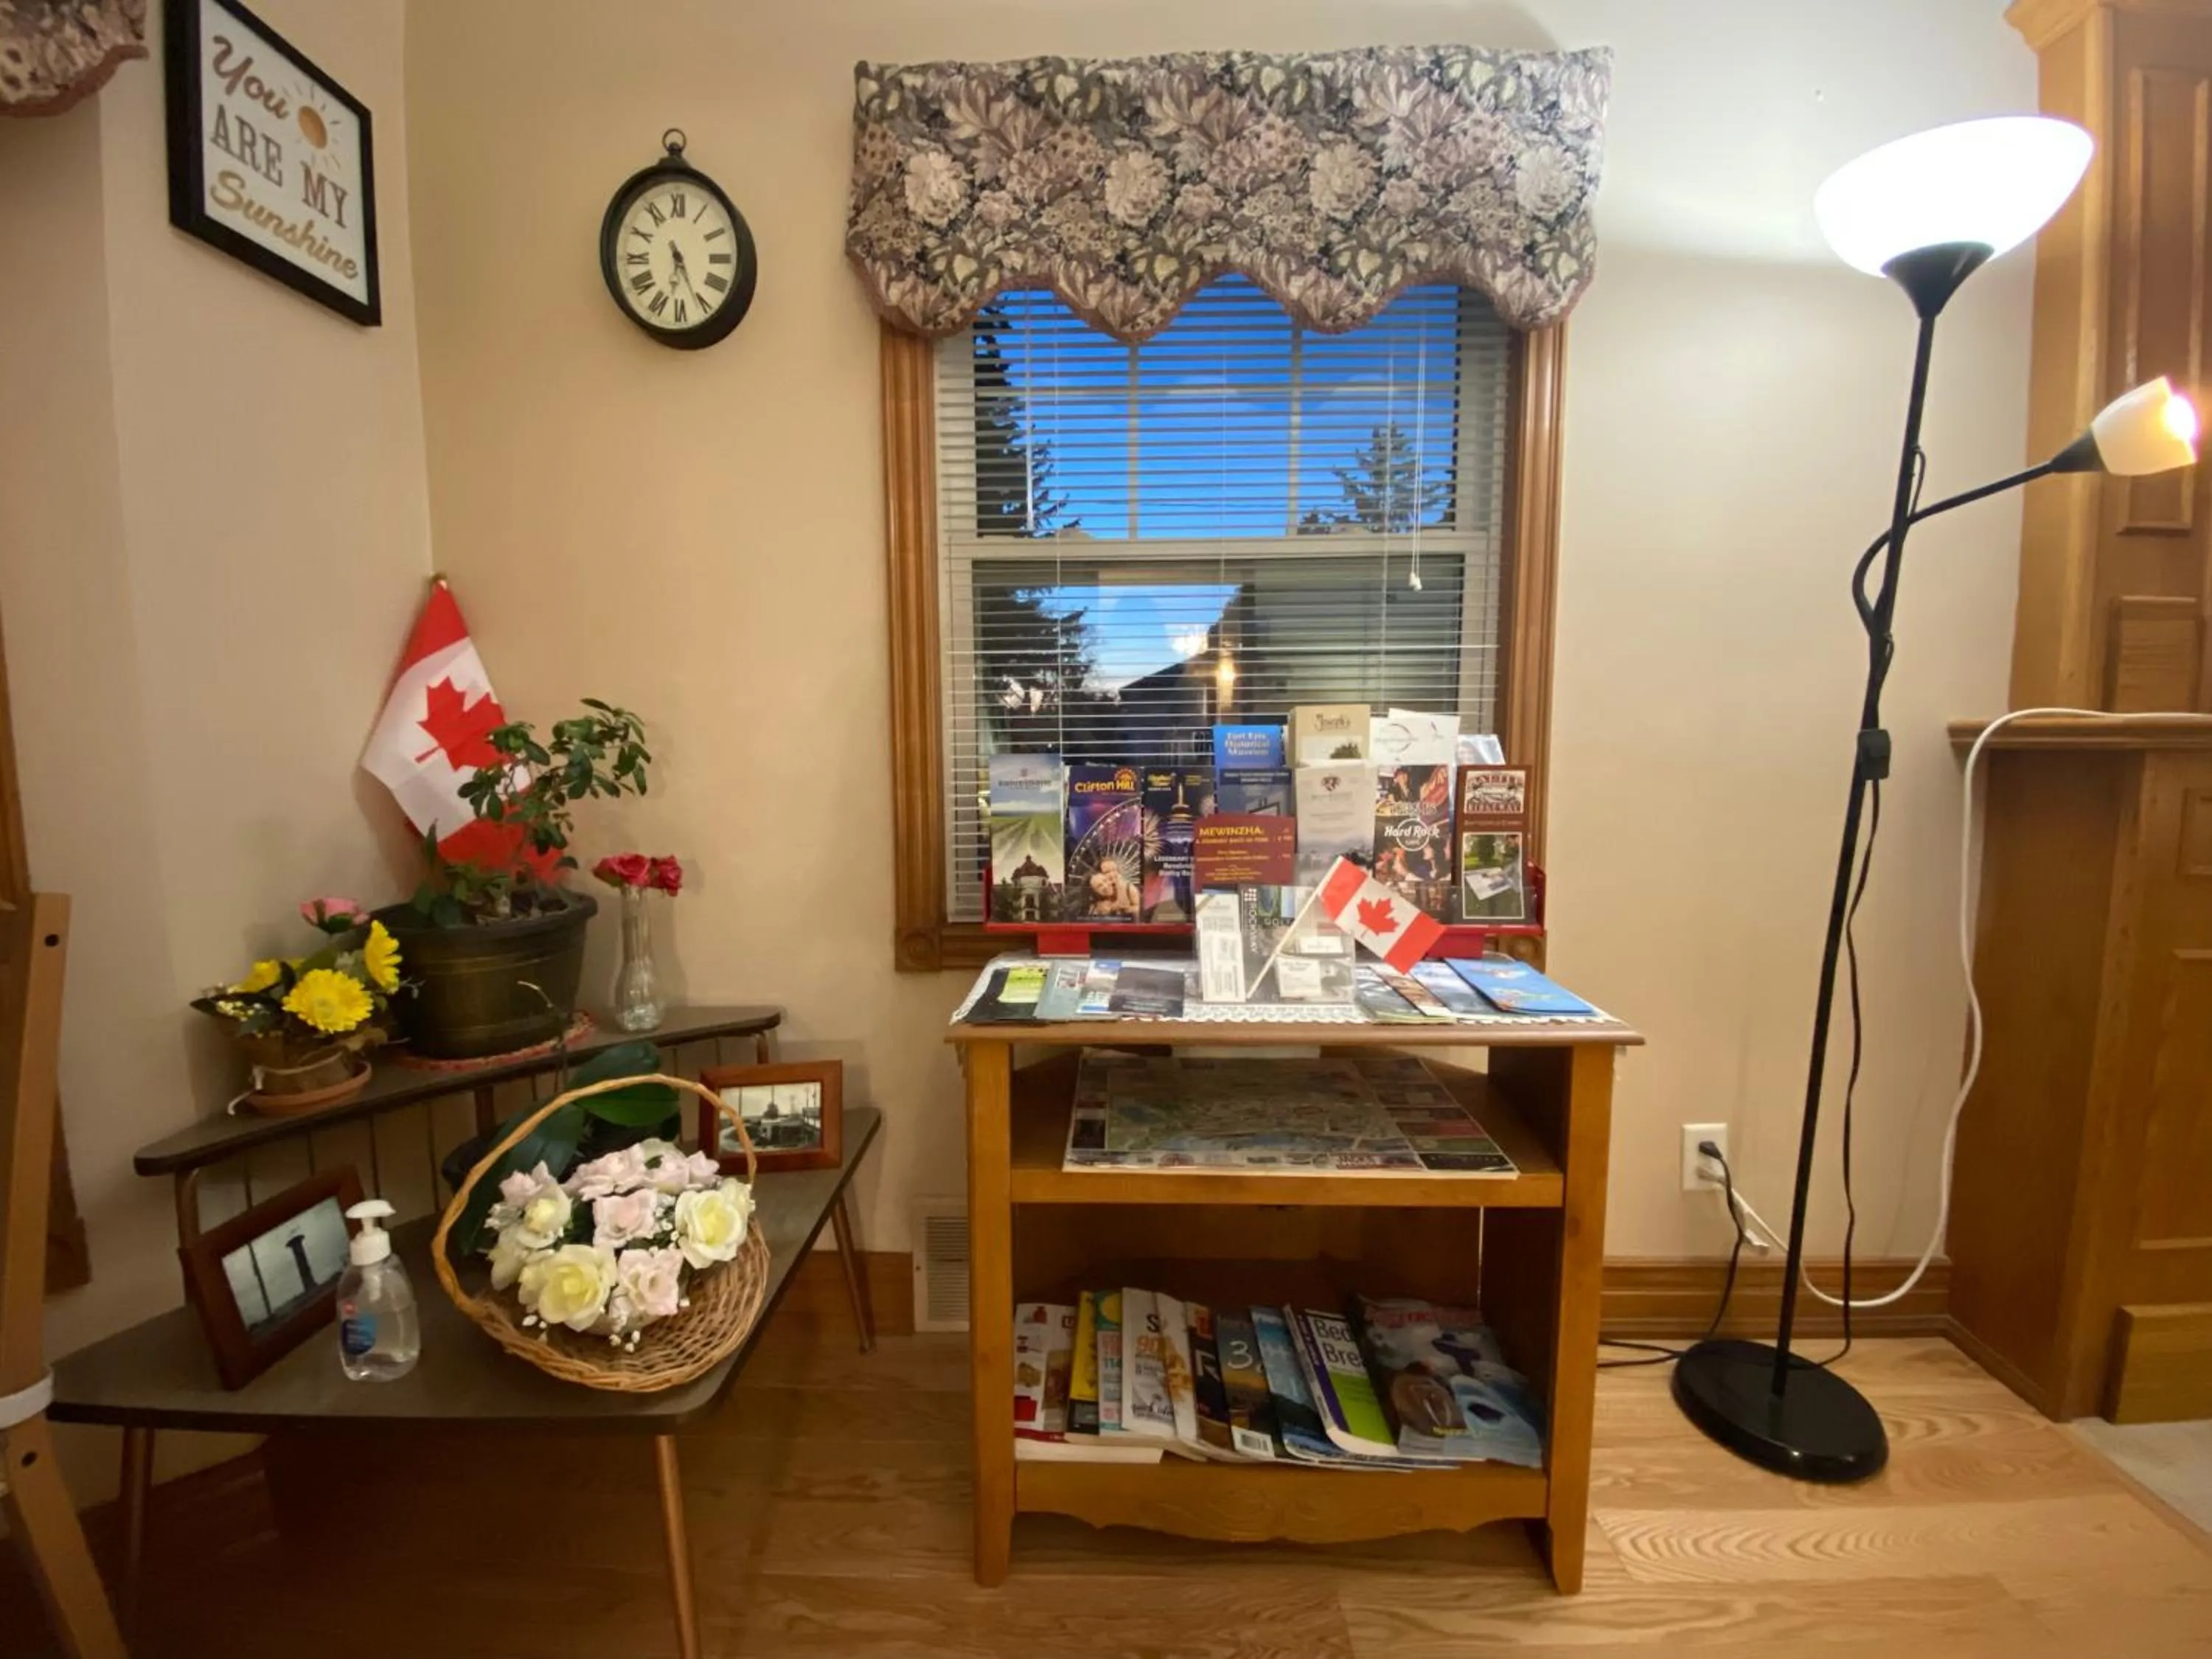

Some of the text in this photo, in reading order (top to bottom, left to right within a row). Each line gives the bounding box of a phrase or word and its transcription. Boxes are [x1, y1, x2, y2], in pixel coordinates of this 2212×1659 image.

[212, 35, 290, 120] You
[209, 104, 349, 229] ARE MY
[644, 202, 666, 227] XI
[670, 193, 685, 218] XII
[209, 170, 359, 280] Sunshine
[630, 226, 653, 244] X
[627, 251, 649, 265] IX
[674, 299, 687, 323] VI
[1074, 781, 1115, 793] Clifton
[1384, 824, 1440, 839] Hard Rock
